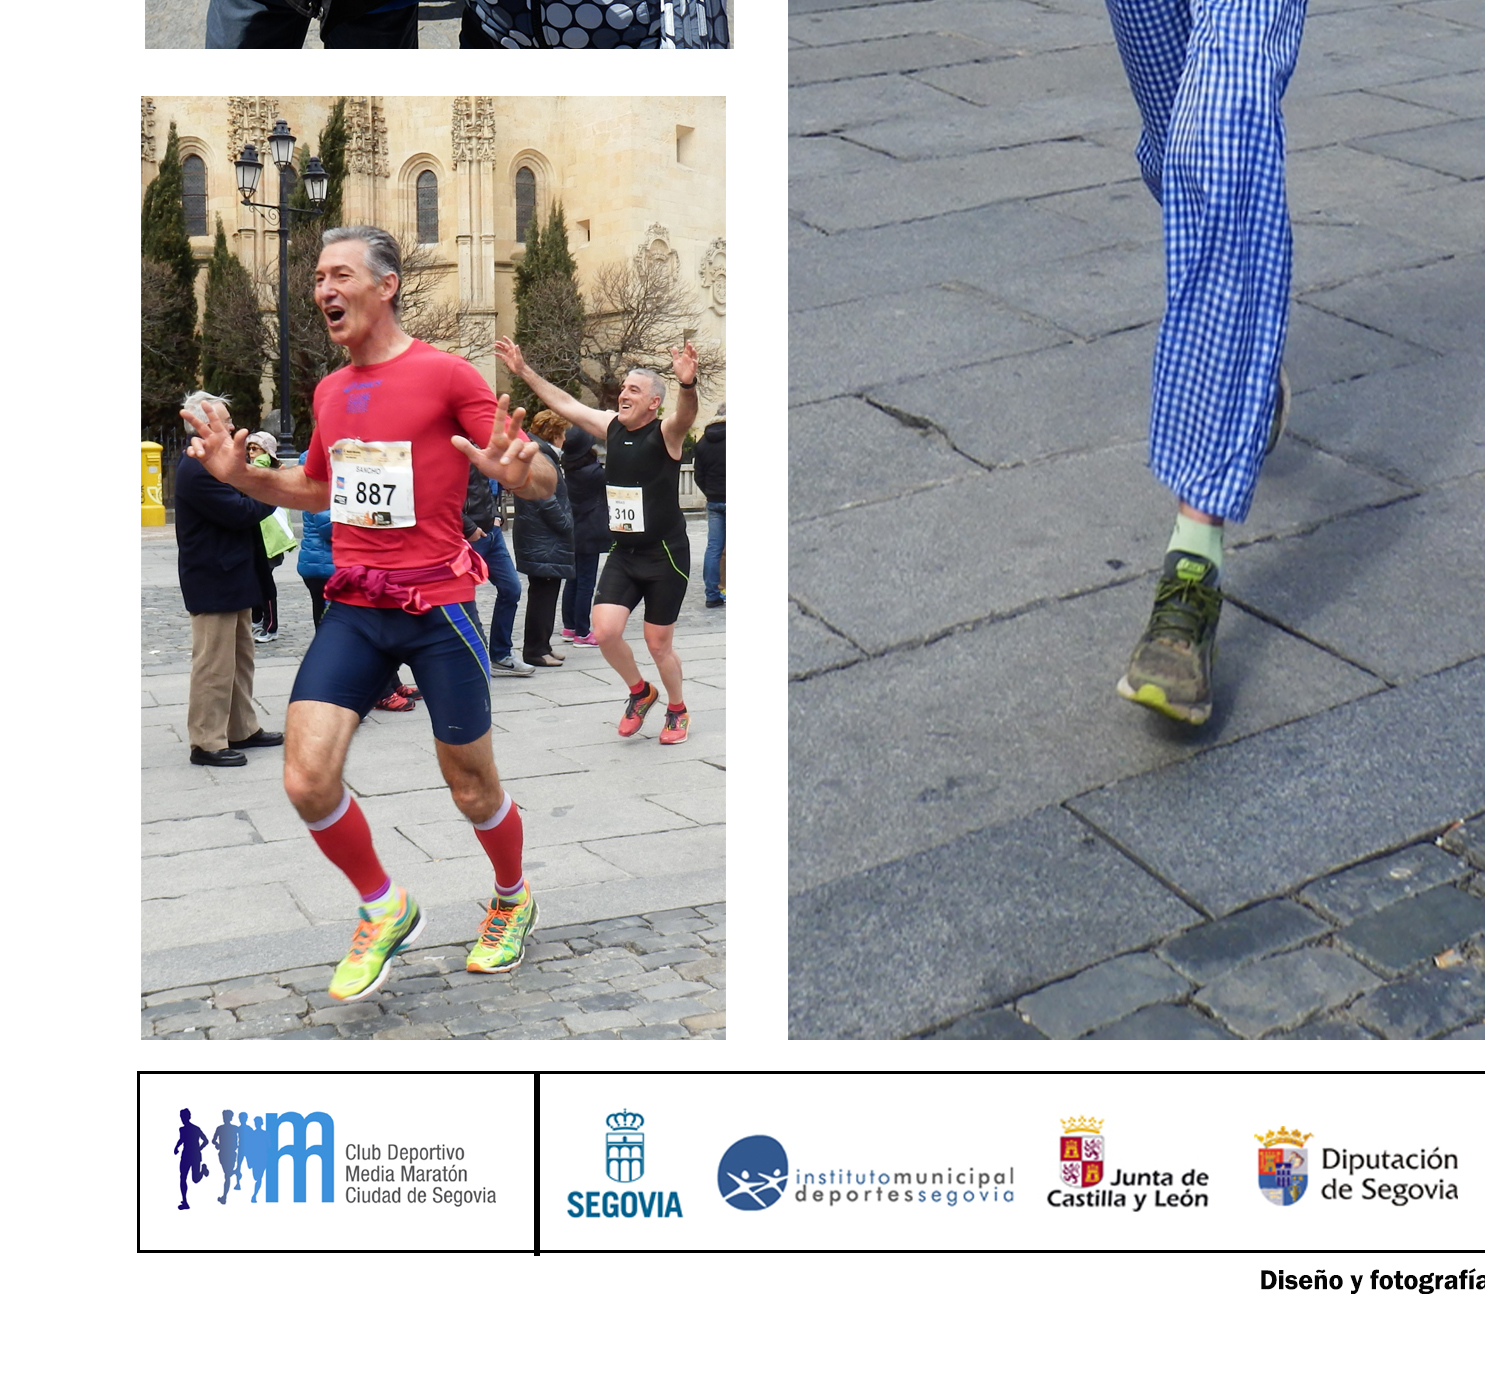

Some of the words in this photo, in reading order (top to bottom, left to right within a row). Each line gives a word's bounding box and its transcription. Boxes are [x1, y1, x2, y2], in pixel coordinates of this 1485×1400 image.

[356, 465, 381, 475] SANCHO
[356, 482, 396, 506] 887
[615, 508, 635, 520] 310
